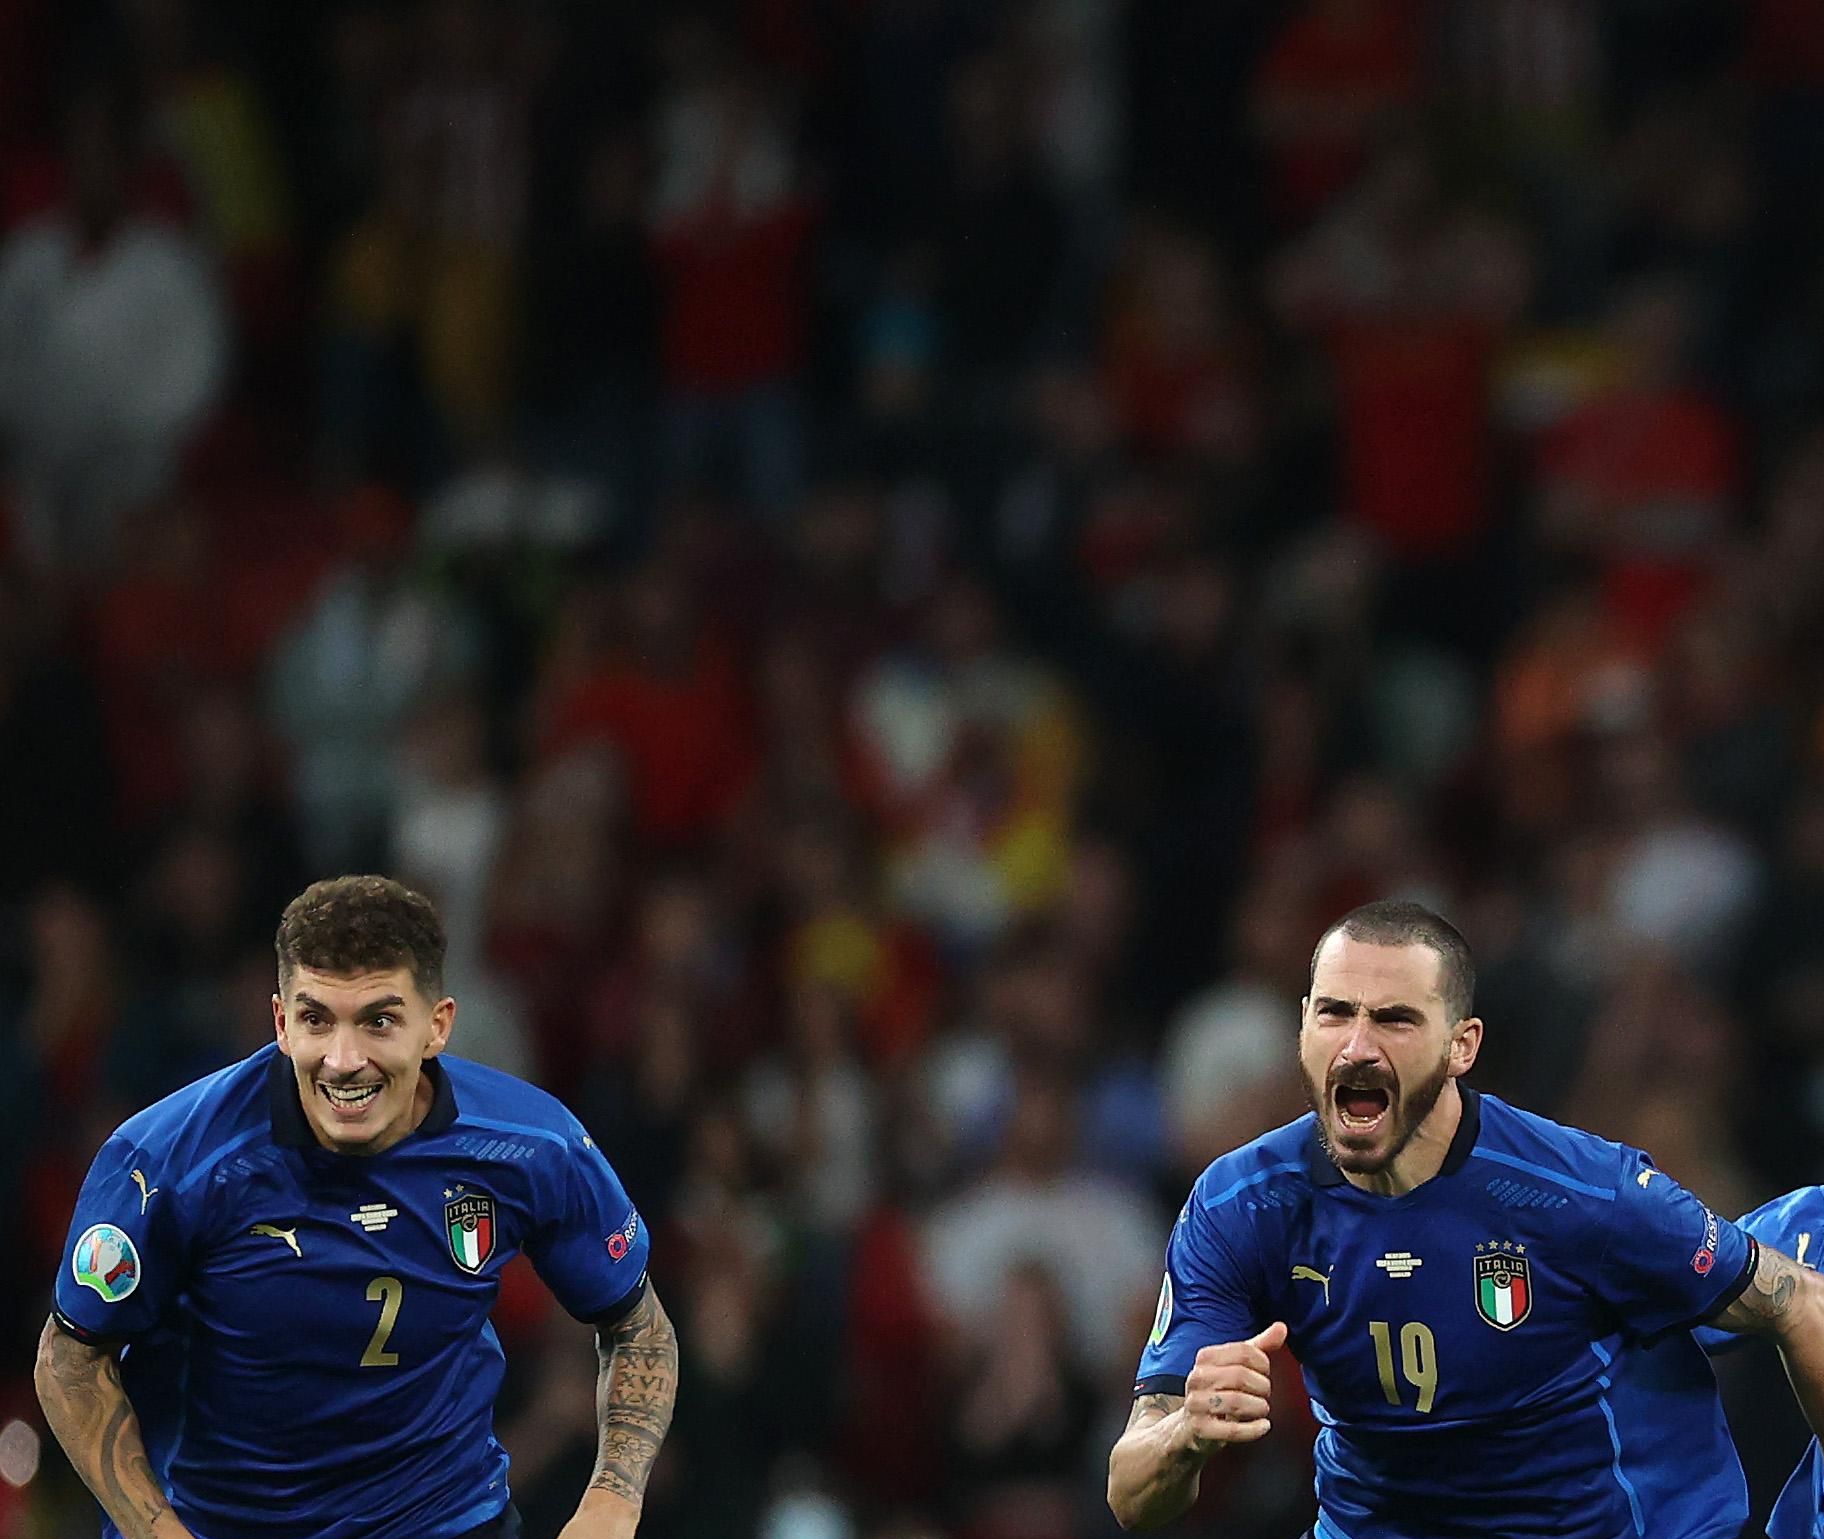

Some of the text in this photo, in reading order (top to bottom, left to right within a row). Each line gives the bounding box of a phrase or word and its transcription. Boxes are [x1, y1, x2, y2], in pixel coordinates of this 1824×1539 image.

[450, 1201, 489, 1218] ITALIA
[1479, 1260, 1524, 1272] ITALIA
[360, 1276, 403, 1367] 2
[1369, 1321, 1437, 1413] 19
